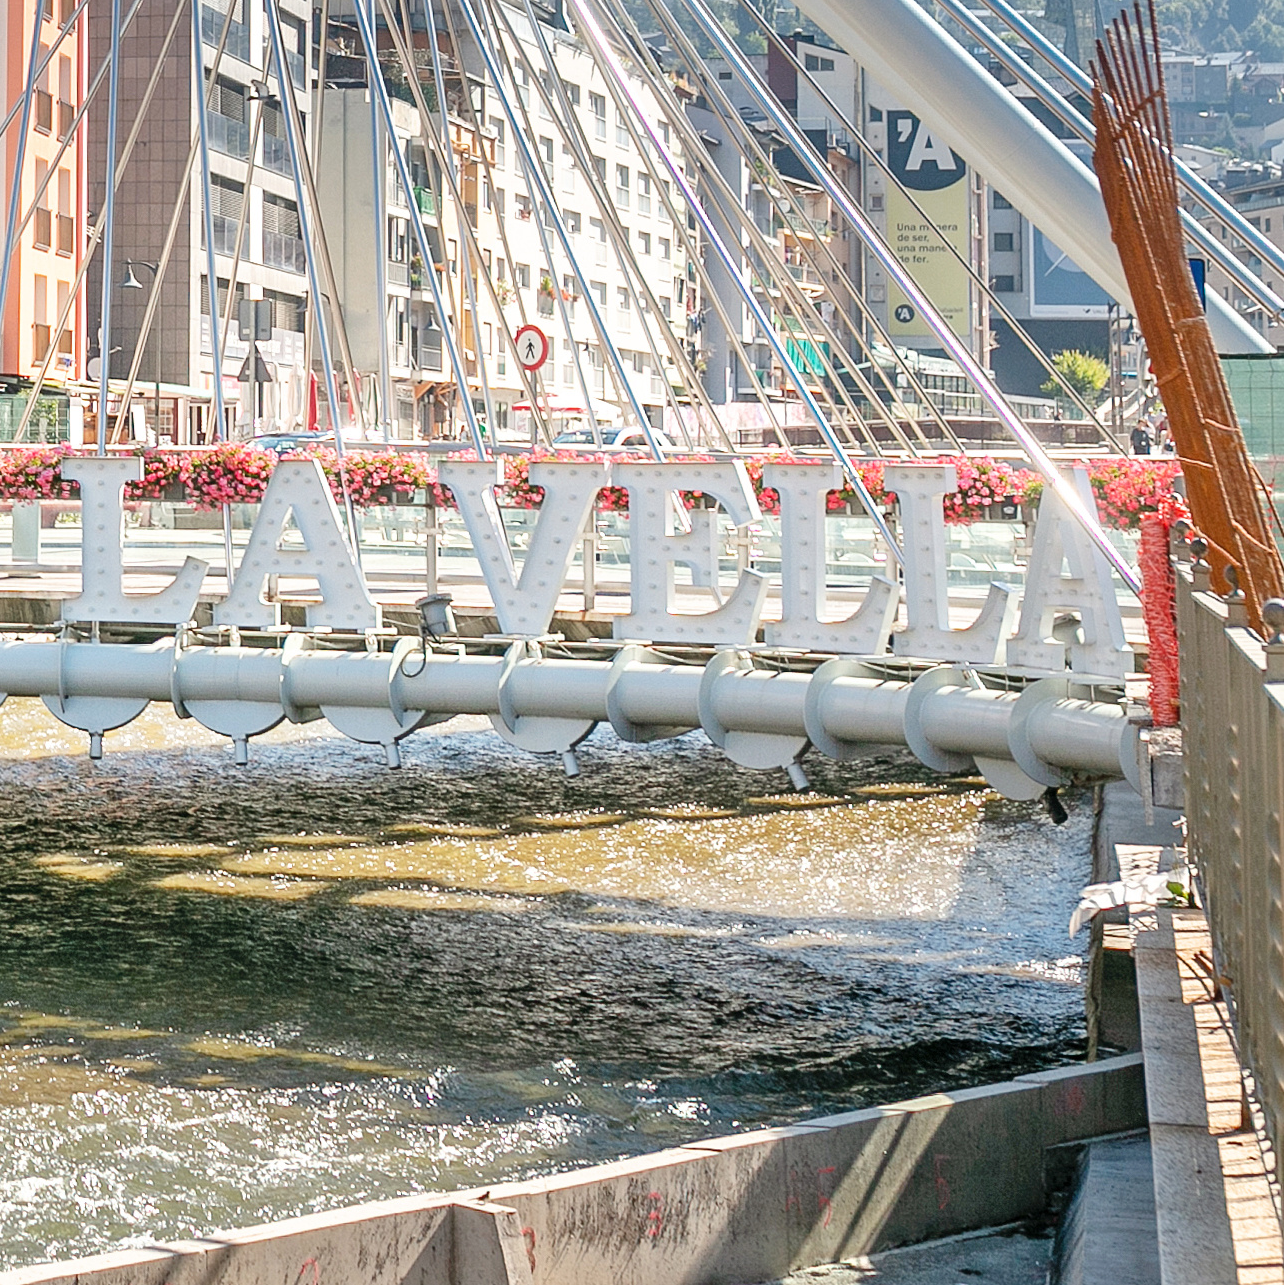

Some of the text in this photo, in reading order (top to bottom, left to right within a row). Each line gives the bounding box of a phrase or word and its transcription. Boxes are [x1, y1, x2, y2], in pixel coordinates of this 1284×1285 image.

[896, 222, 917, 232] Una
[896, 233, 910, 242] de
[62, 455, 382, 630] LA
[438, 458, 1136, 678] VELLA
